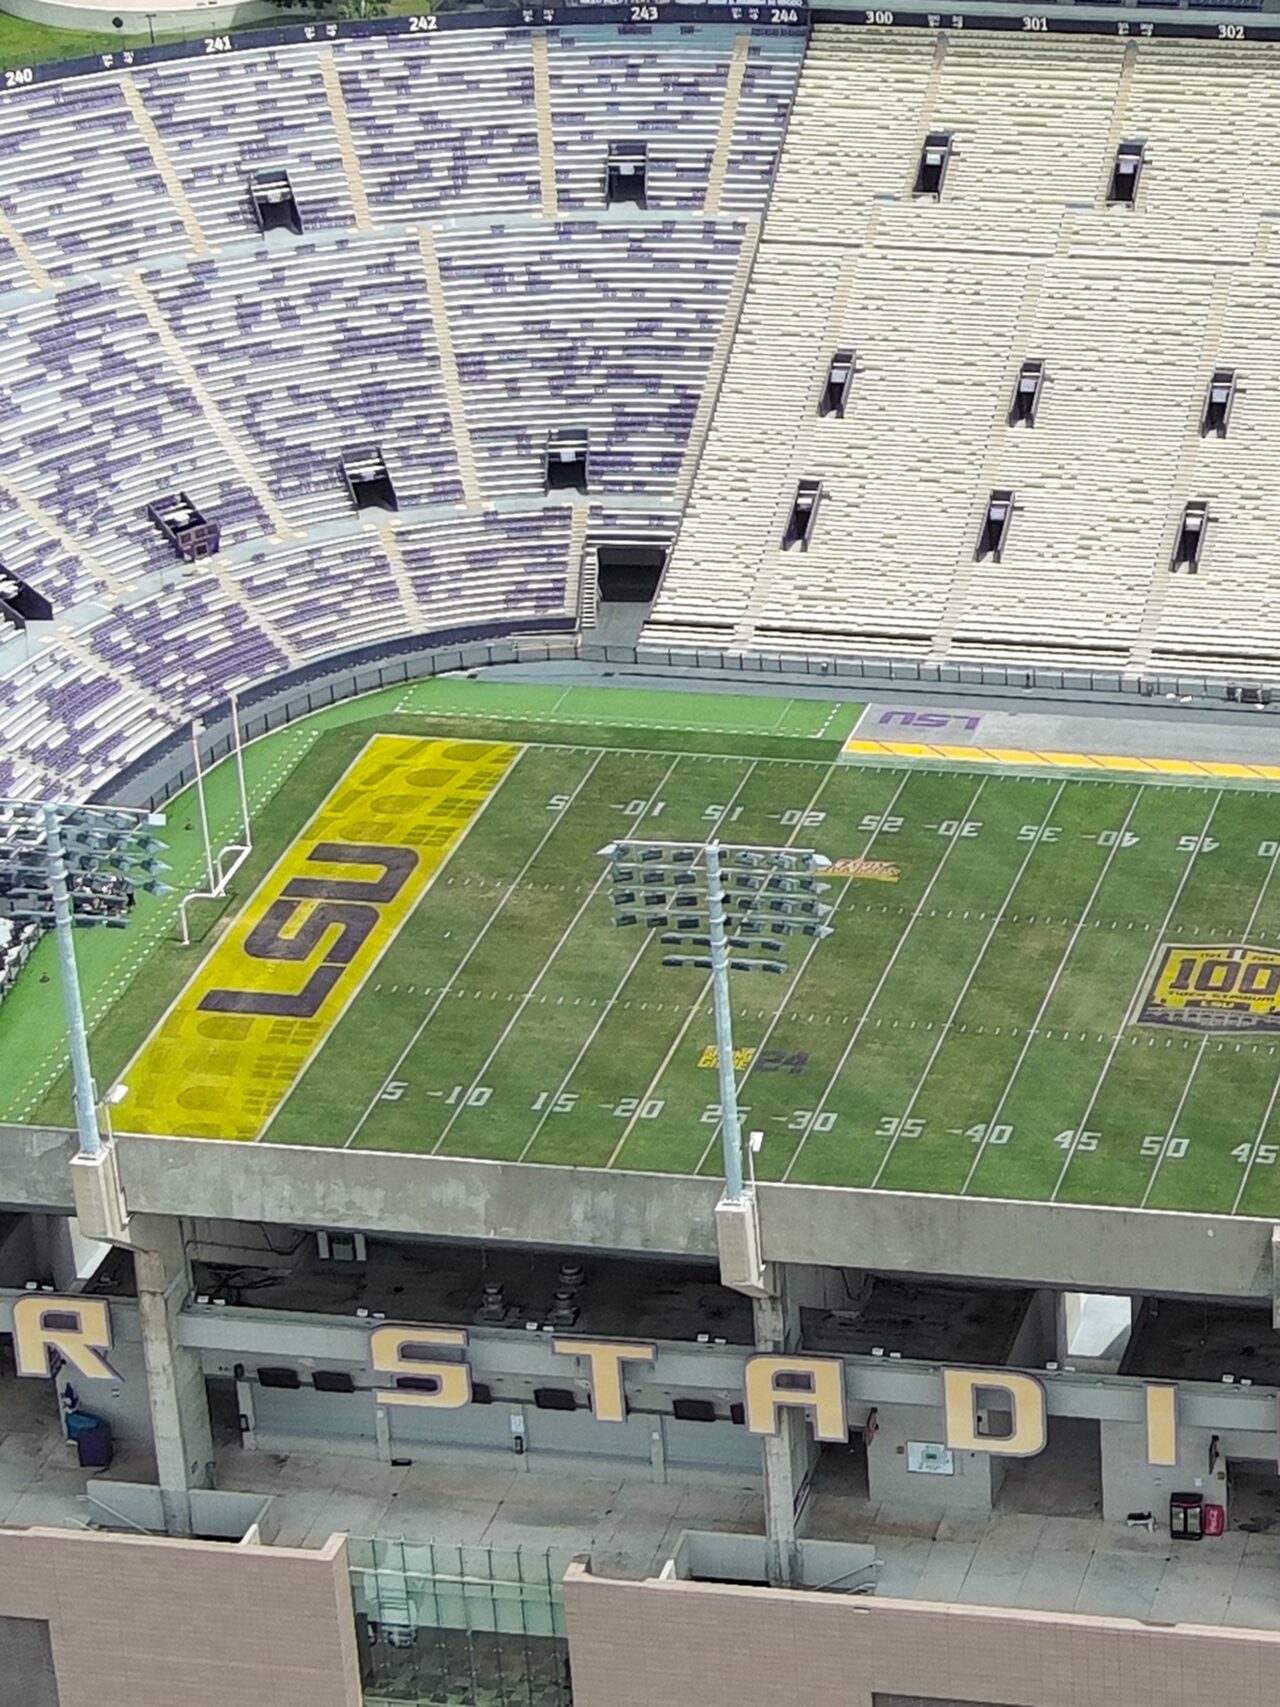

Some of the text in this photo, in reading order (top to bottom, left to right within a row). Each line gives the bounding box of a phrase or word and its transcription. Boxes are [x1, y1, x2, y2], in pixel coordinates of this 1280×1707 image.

[632, 7, 658, 21] 243
[771, 9, 798, 22] 244
[866, 11, 893, 25] 300
[409, 16, 437, 31] 242
[1023, 17, 1048, 31] 301
[1218, 25, 1245, 39] 302
[205, 36, 232, 53] 241
[5, 67, 33, 86] 240
[878, 711, 981, 731] LSU
[546, 795, 569, 811] 5
[622, 800, 666, 816] 10
[701, 805, 744, 822] 15
[779, 810, 826, 826] 20
[858, 815, 905, 832] 25
[937, 820, 983, 838] 30
[1016, 825, 1063, 842] 35
[1097, 830, 1140, 848] 40
[1176, 835, 1221, 853] 45
[196, 842, 420, 1018] LSU
[380, 1082, 408, 1100] 5
[445, 1086, 493, 1107] 10
[531, 1091, 579, 1113] 15
[612, 1098, 665, 1119] 20
[787, 1111, 839, 1132] 30
[875, 1117, 926, 1139] 35
[964, 1123, 1013, 1145] 40
[1053, 1129, 1101, 1152] 45
[1139, 1136, 1190, 1159] 50
[1231, 1143, 1280, 1165] 45
[13, 1292, 124, 1381] R
